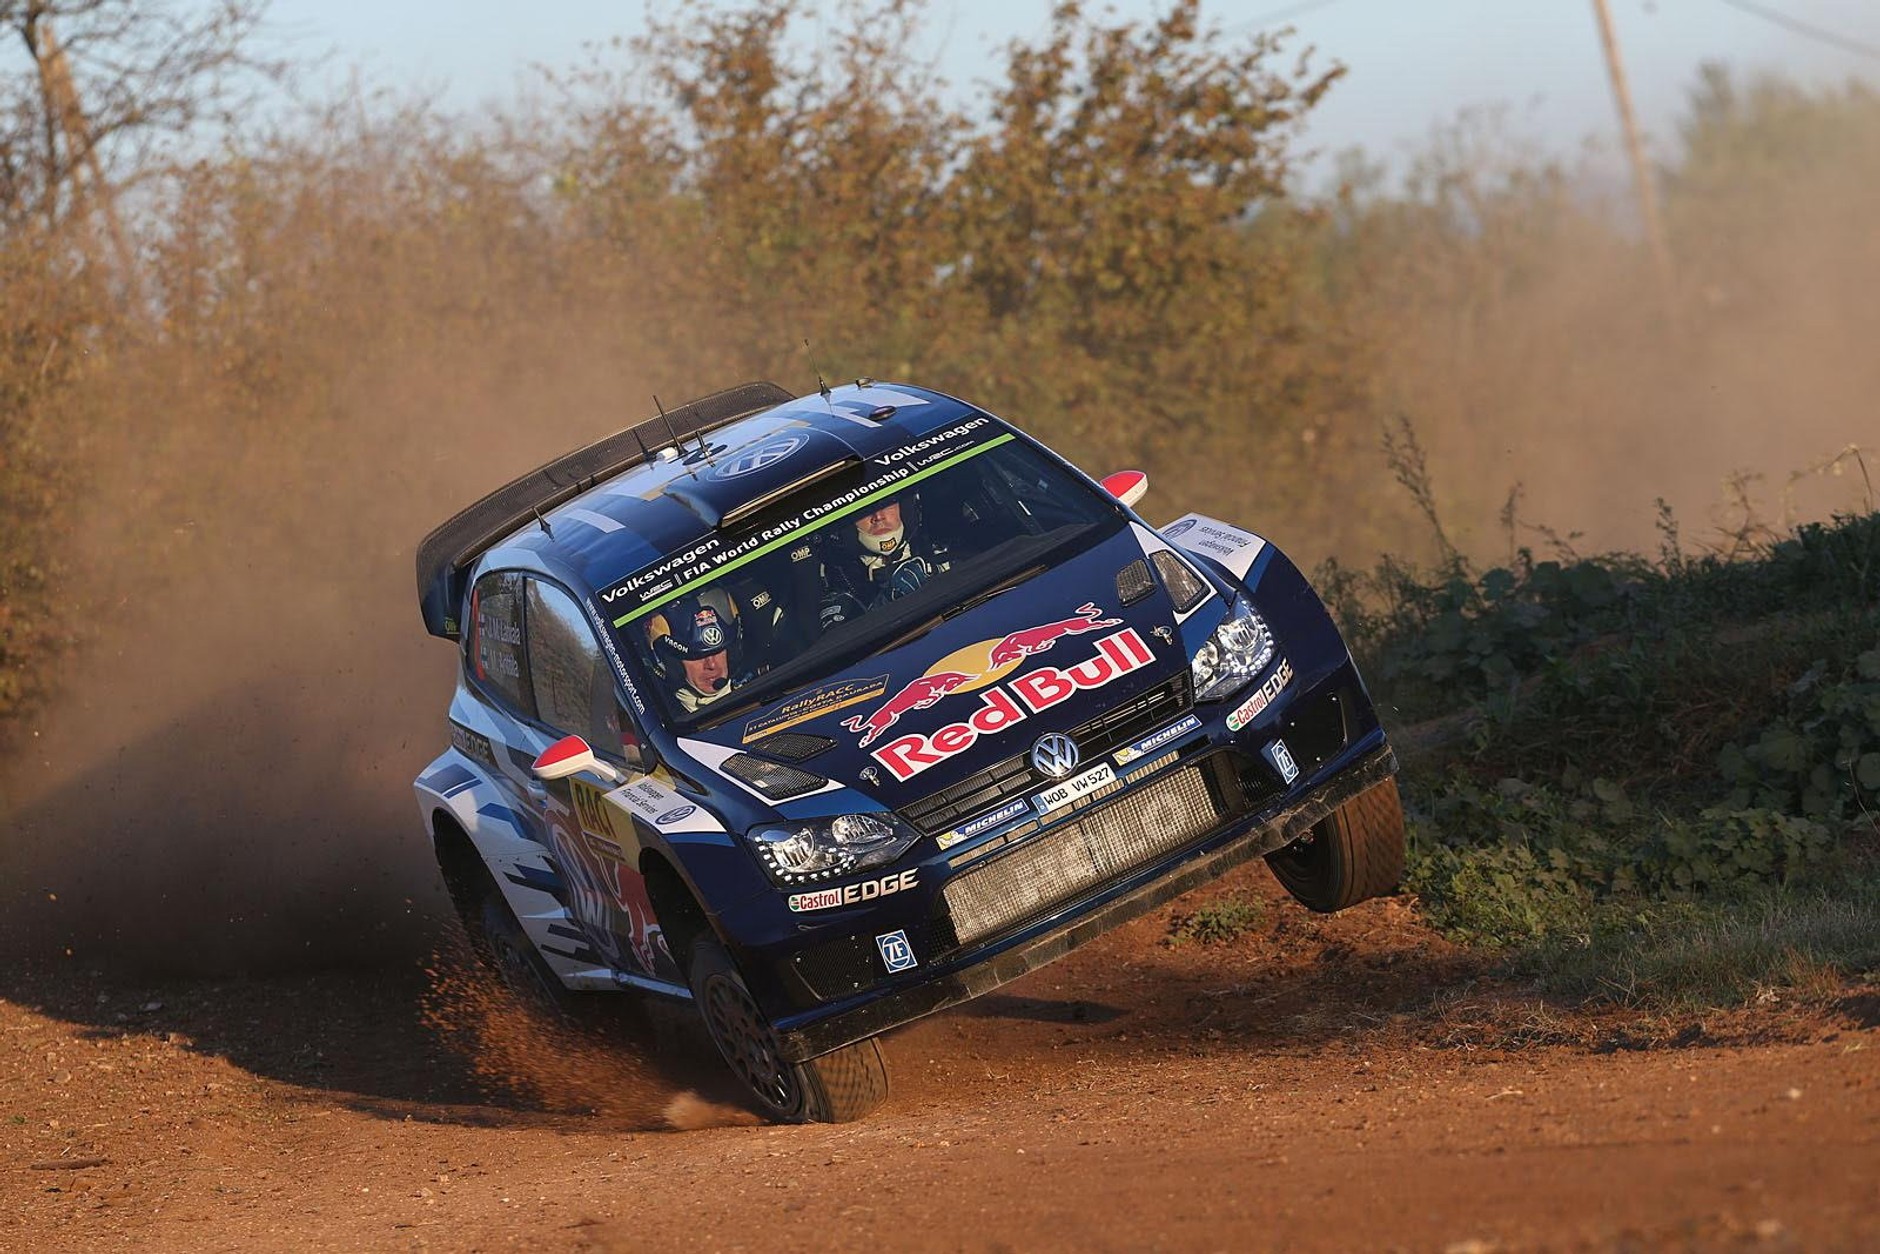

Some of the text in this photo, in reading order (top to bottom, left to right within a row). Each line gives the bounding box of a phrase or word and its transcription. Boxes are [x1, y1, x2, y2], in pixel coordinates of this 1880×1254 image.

[875, 417, 989, 467] Volkswagen
[683, 561, 712, 581] FIA
[712, 538, 759, 565] World
[762, 517, 801, 541] Rally
[803, 467, 909, 520] Championship
[602, 538, 719, 604] Volkswagen
[791, 546, 811, 561] OMP
[781, 683, 856, 715] RallyRACC
[869, 627, 1157, 783] Red Bull
[1237, 657, 1294, 725] Castrol EDGE
[1141, 716, 1195, 750] MICHELIN
[964, 801, 1024, 835] MICHELIN
[1043, 788, 1069, 806] WOB
[800, 867, 919, 910] Castrol EDGE
